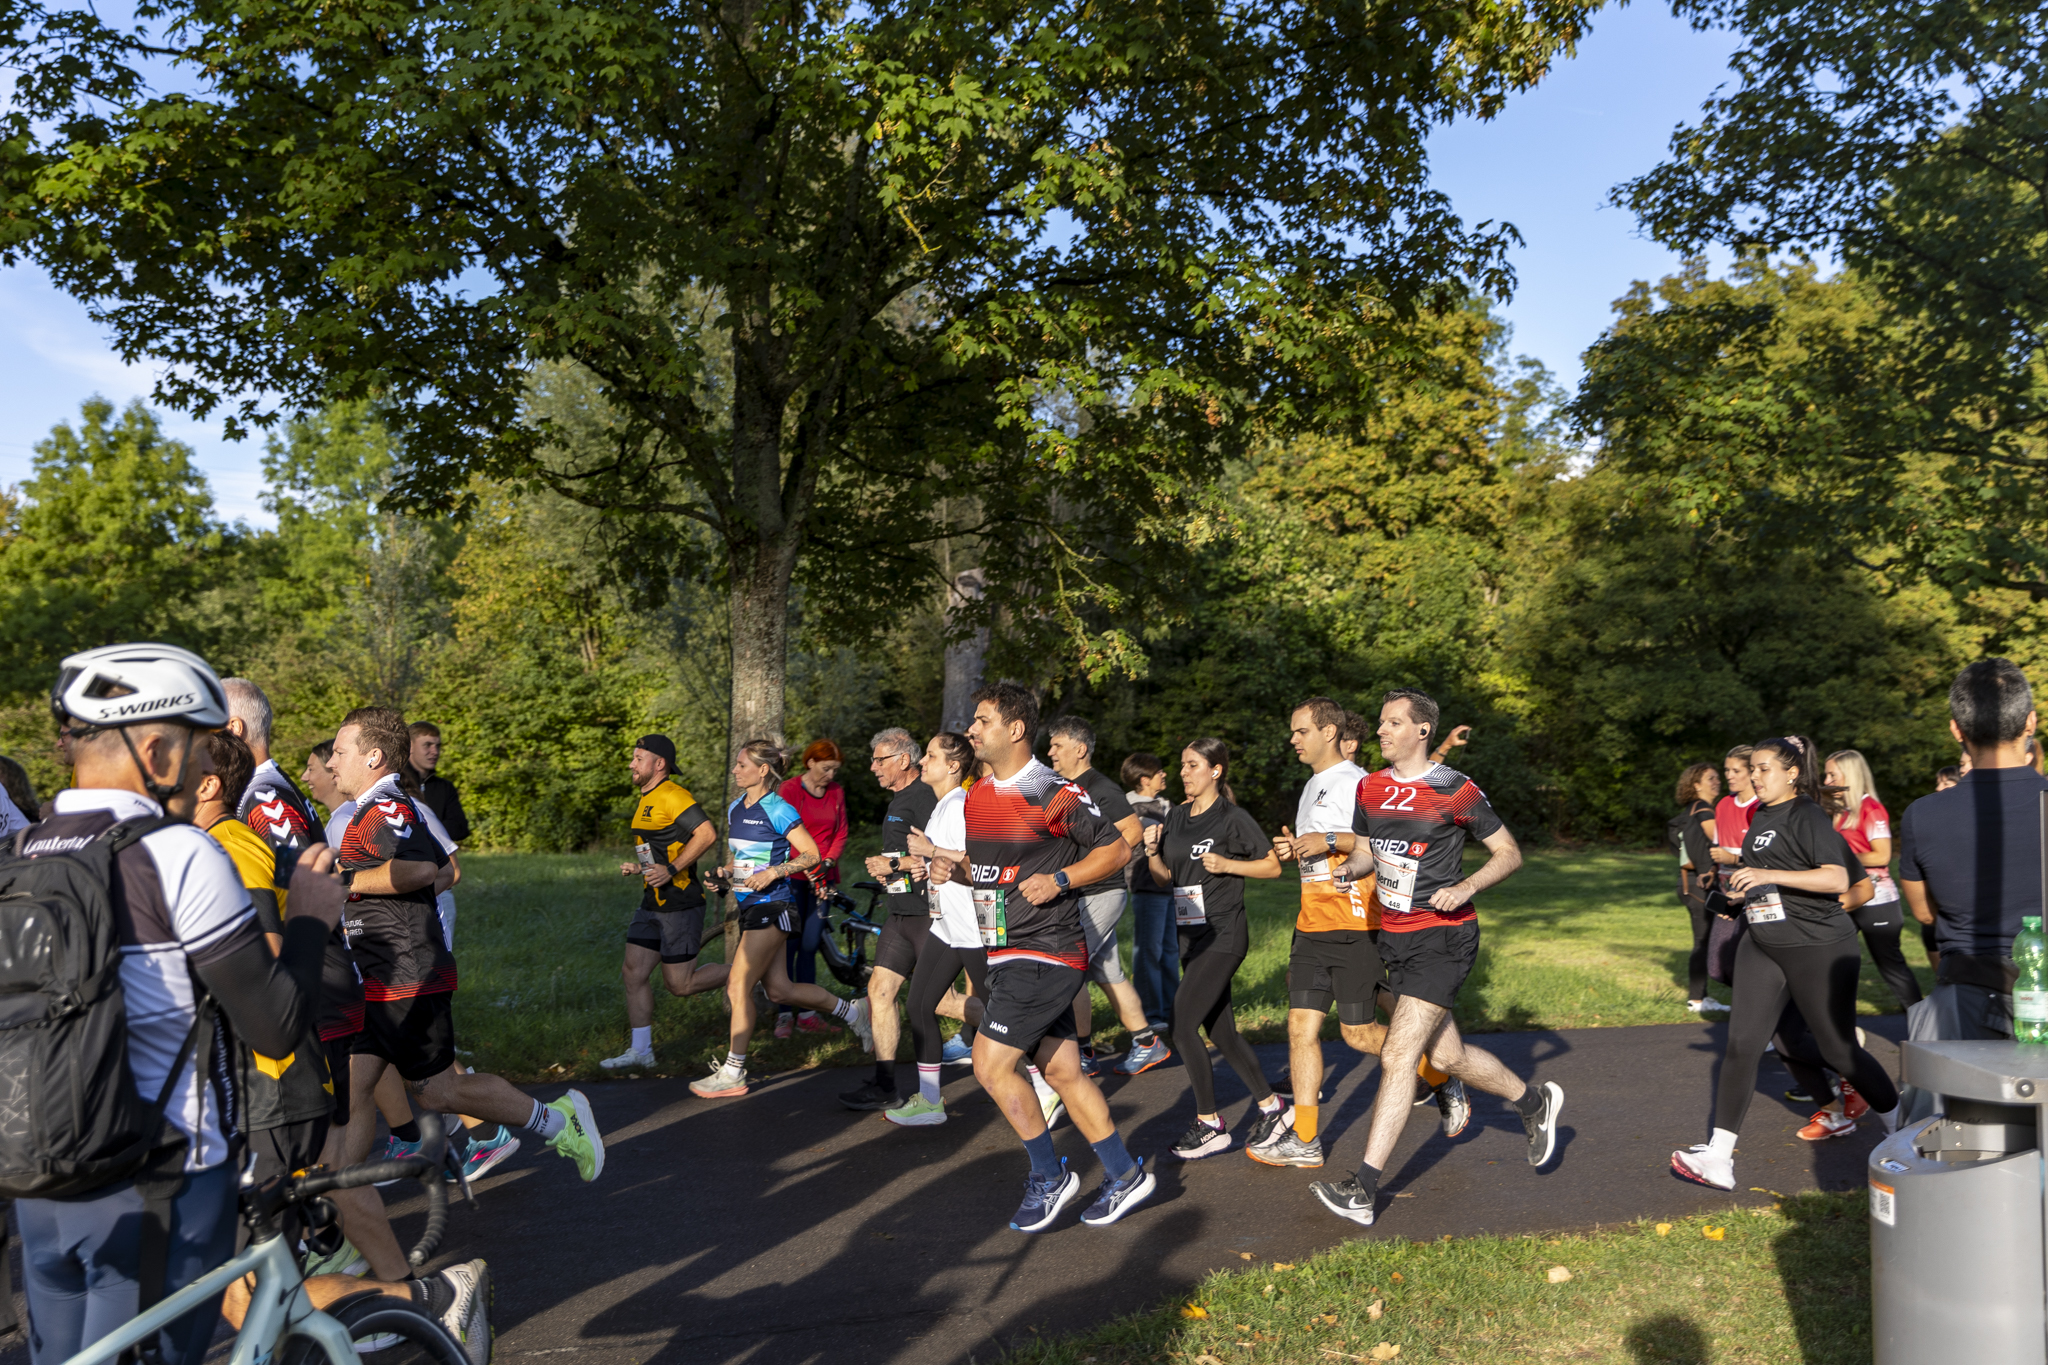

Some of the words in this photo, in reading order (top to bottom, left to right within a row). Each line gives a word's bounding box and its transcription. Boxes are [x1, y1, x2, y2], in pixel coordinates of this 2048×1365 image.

[98, 692, 197, 720] S-WORKS
[1380, 785, 1417, 811] 22
[970, 863, 1000, 883] RIED
[1388, 900, 1401, 909] 448
[989, 1020, 1008, 1034] JAKO
[1200, 1130, 1217, 1144] HOKA
